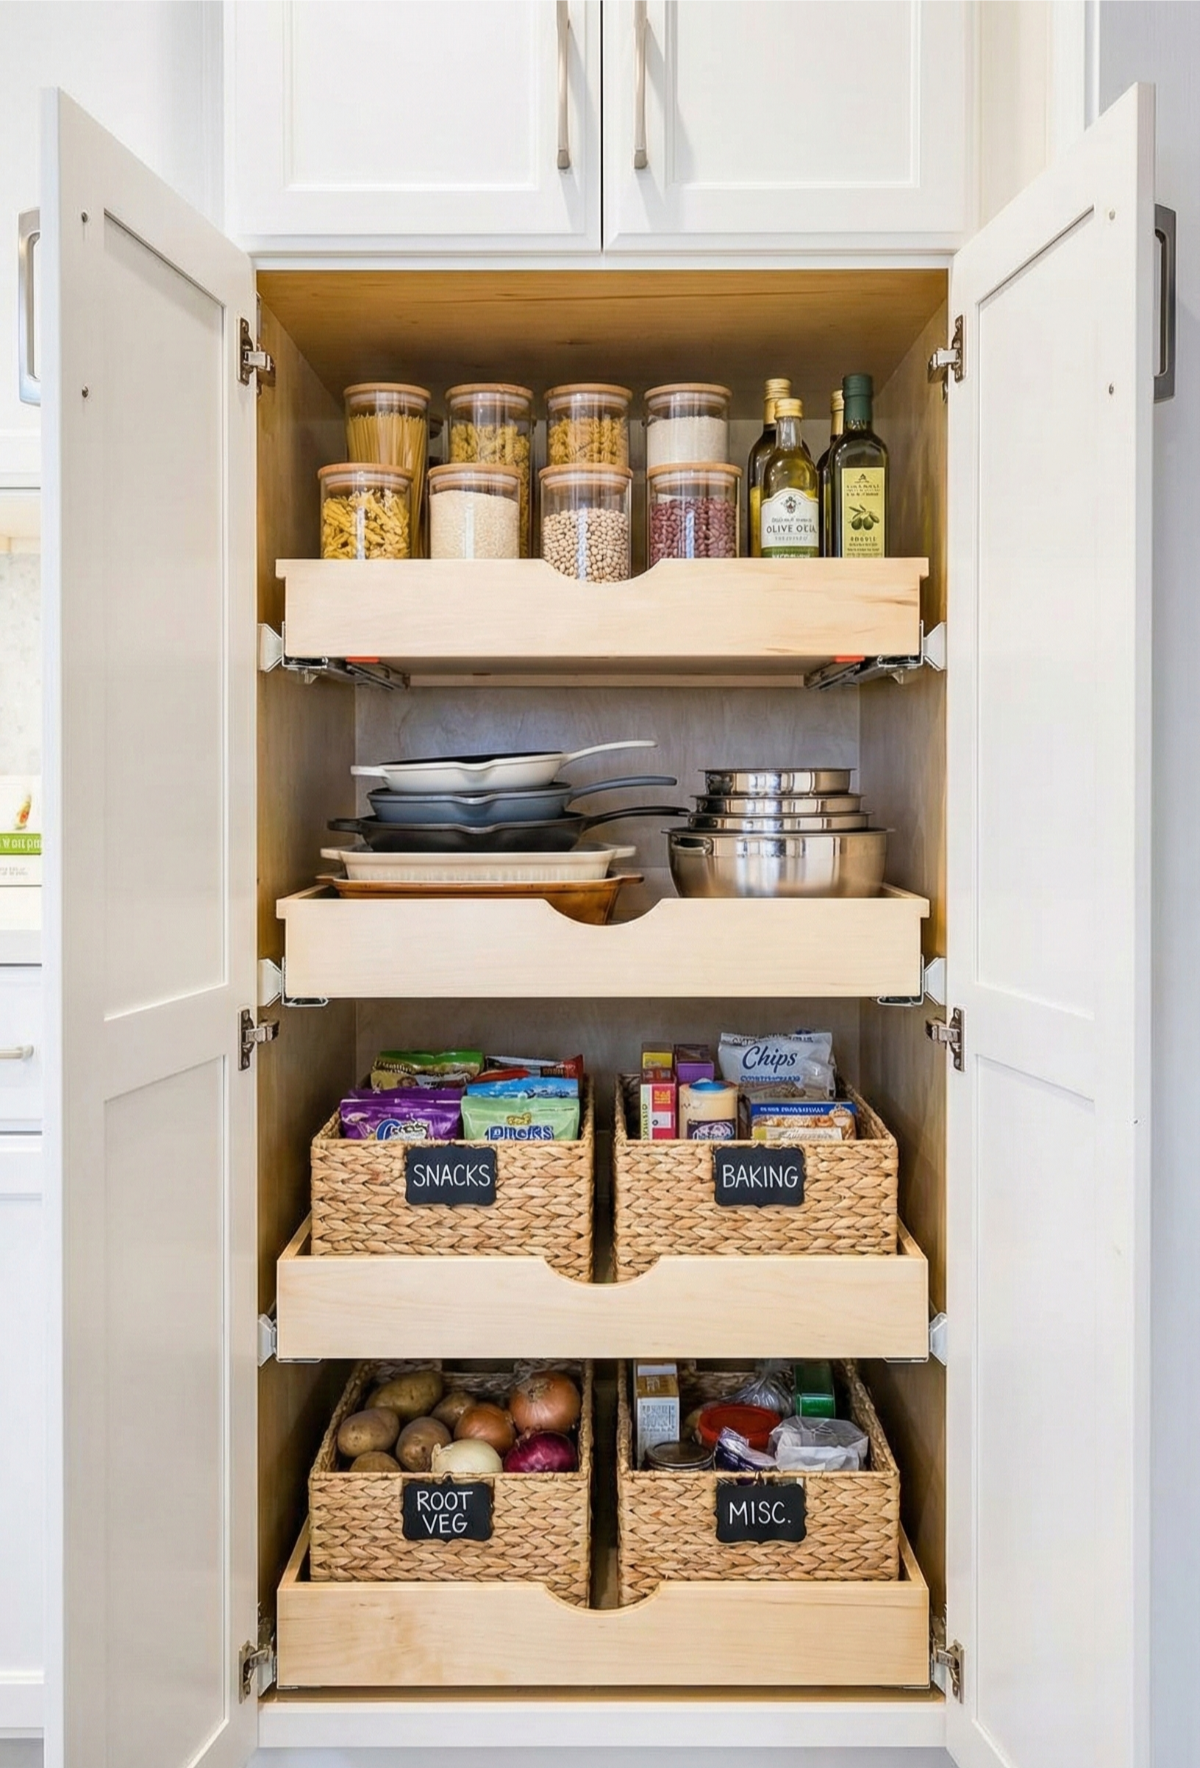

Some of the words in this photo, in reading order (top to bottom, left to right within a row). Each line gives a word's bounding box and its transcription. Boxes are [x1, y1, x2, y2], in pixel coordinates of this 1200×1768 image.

[766, 524, 793, 534] OLIVE
[742, 1045, 798, 1074] Chips
[412, 1164, 491, 1188] SNACKS
[722, 1164, 799, 1189] BAKING
[416, 1490, 474, 1512] ROOT
[728, 1500, 792, 1526] MISC.
[421, 1513, 468, 1535] VEG
